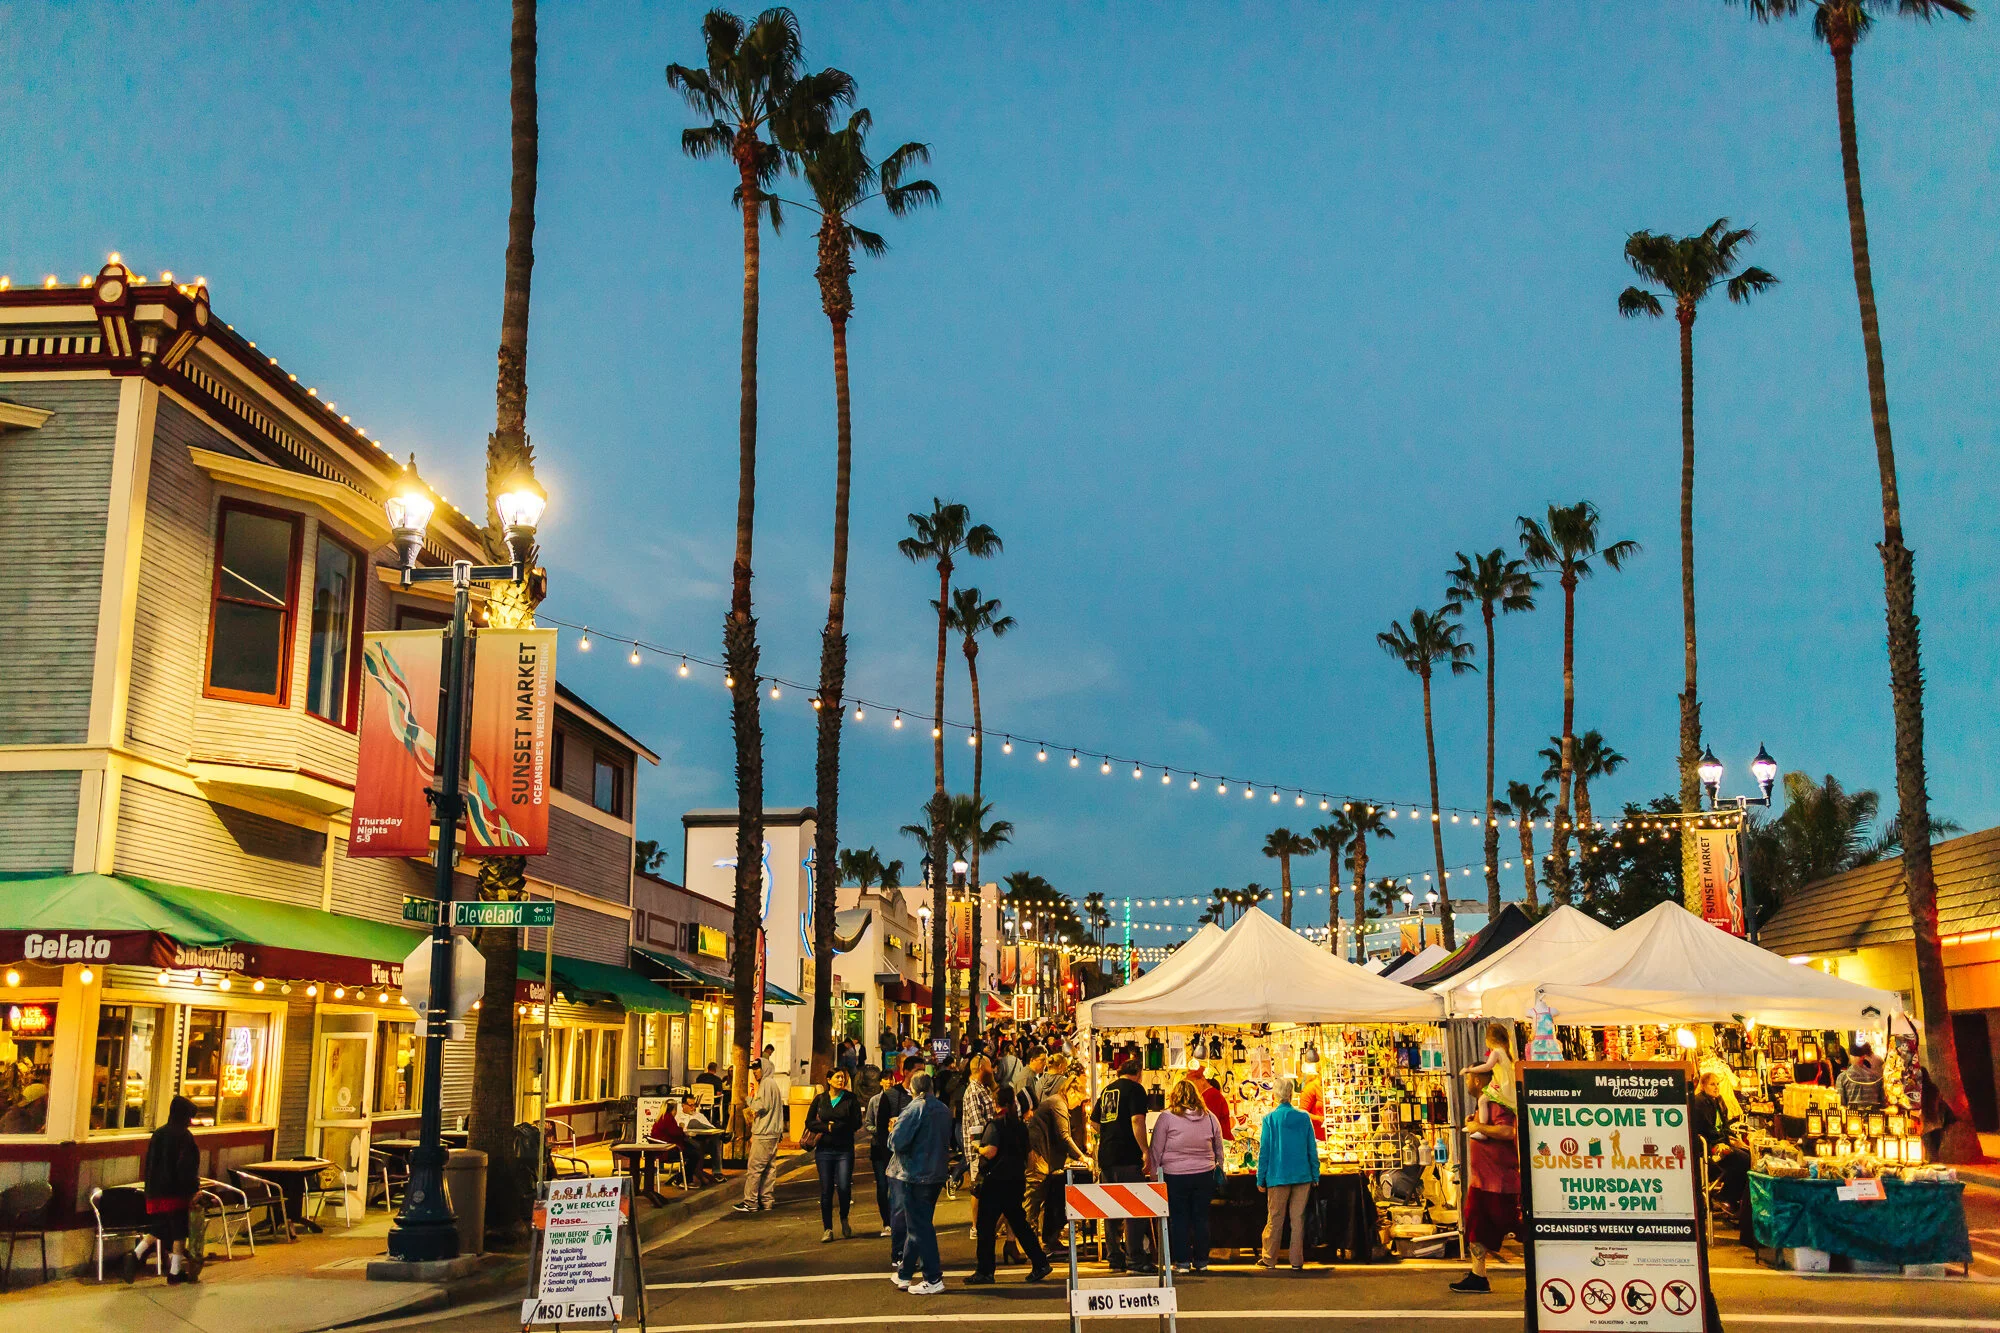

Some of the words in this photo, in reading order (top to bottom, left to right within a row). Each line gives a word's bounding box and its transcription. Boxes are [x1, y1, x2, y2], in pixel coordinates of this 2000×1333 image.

[538, 642, 549, 696] GATHERING
[516, 642, 536, 720] MARKET
[536, 699, 546, 739] WEEKLY
[512, 728, 531, 805] SUNSET
[533, 740, 544, 804] OCEANSIDE'S
[358, 818, 402, 826] Thursday
[358, 826, 388, 835] Nights
[1701, 836, 1712, 874] MARKET
[1704, 878, 1716, 914] SUNSET
[456, 905, 522, 924] Cleveland
[24, 934, 111, 958] Gelato
[372, 964, 390, 984] Pier
[25, 1009, 41, 1018] ICE
[21, 1018, 46, 1028] CREAM
[1596, 1076, 1674, 1087] MainStreet
[1612, 1085, 1658, 1100] Oceanside
[1530, 1108, 1646, 1126] WELCOME
[1652, 1108, 1684, 1128] TO
[1532, 1155, 1604, 1169] SUNSET
[1611, 1155, 1686, 1170] MARKET
[1560, 1178, 1663, 1193] THURSDAYS
[581, 1200, 615, 1208] RECYCLE
[1568, 1196, 1606, 1210] 5PM
[1618, 1196, 1656, 1210] 9PM
[1536, 1224, 1597, 1233] OCEANSIDE'S
[1600, 1225, 1634, 1234] WEEKLY
[1636, 1225, 1691, 1234] GATHERING
[560, 1248, 583, 1256] soliciting
[1088, 1295, 1113, 1310] MSO
[1120, 1293, 1160, 1308] Events
[538, 1304, 562, 1320] MSO
[568, 1302, 607, 1318] Events
